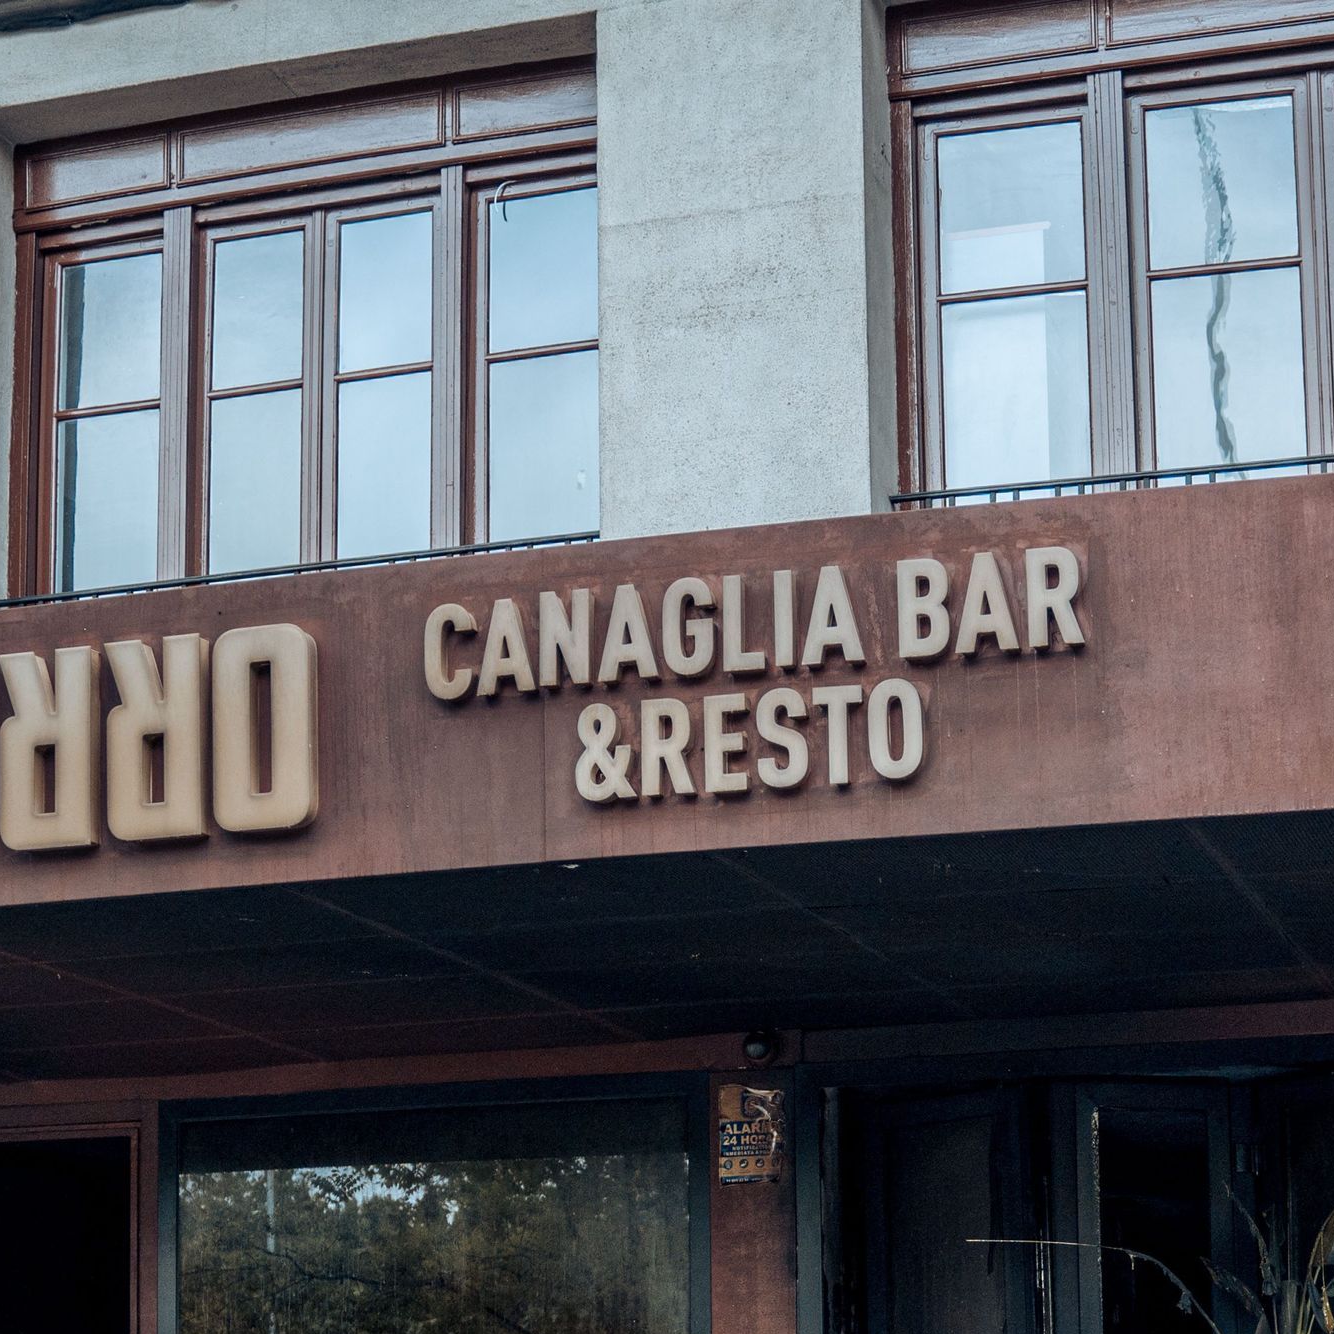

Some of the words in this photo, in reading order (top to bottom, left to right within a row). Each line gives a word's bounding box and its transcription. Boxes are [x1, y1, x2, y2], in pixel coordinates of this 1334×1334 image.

[423, 562, 868, 701] CANAGLIA
[896, 545, 1088, 661] BAR
[575, 676, 929, 804] &RESTO
[723, 1135, 737, 1146] 24
